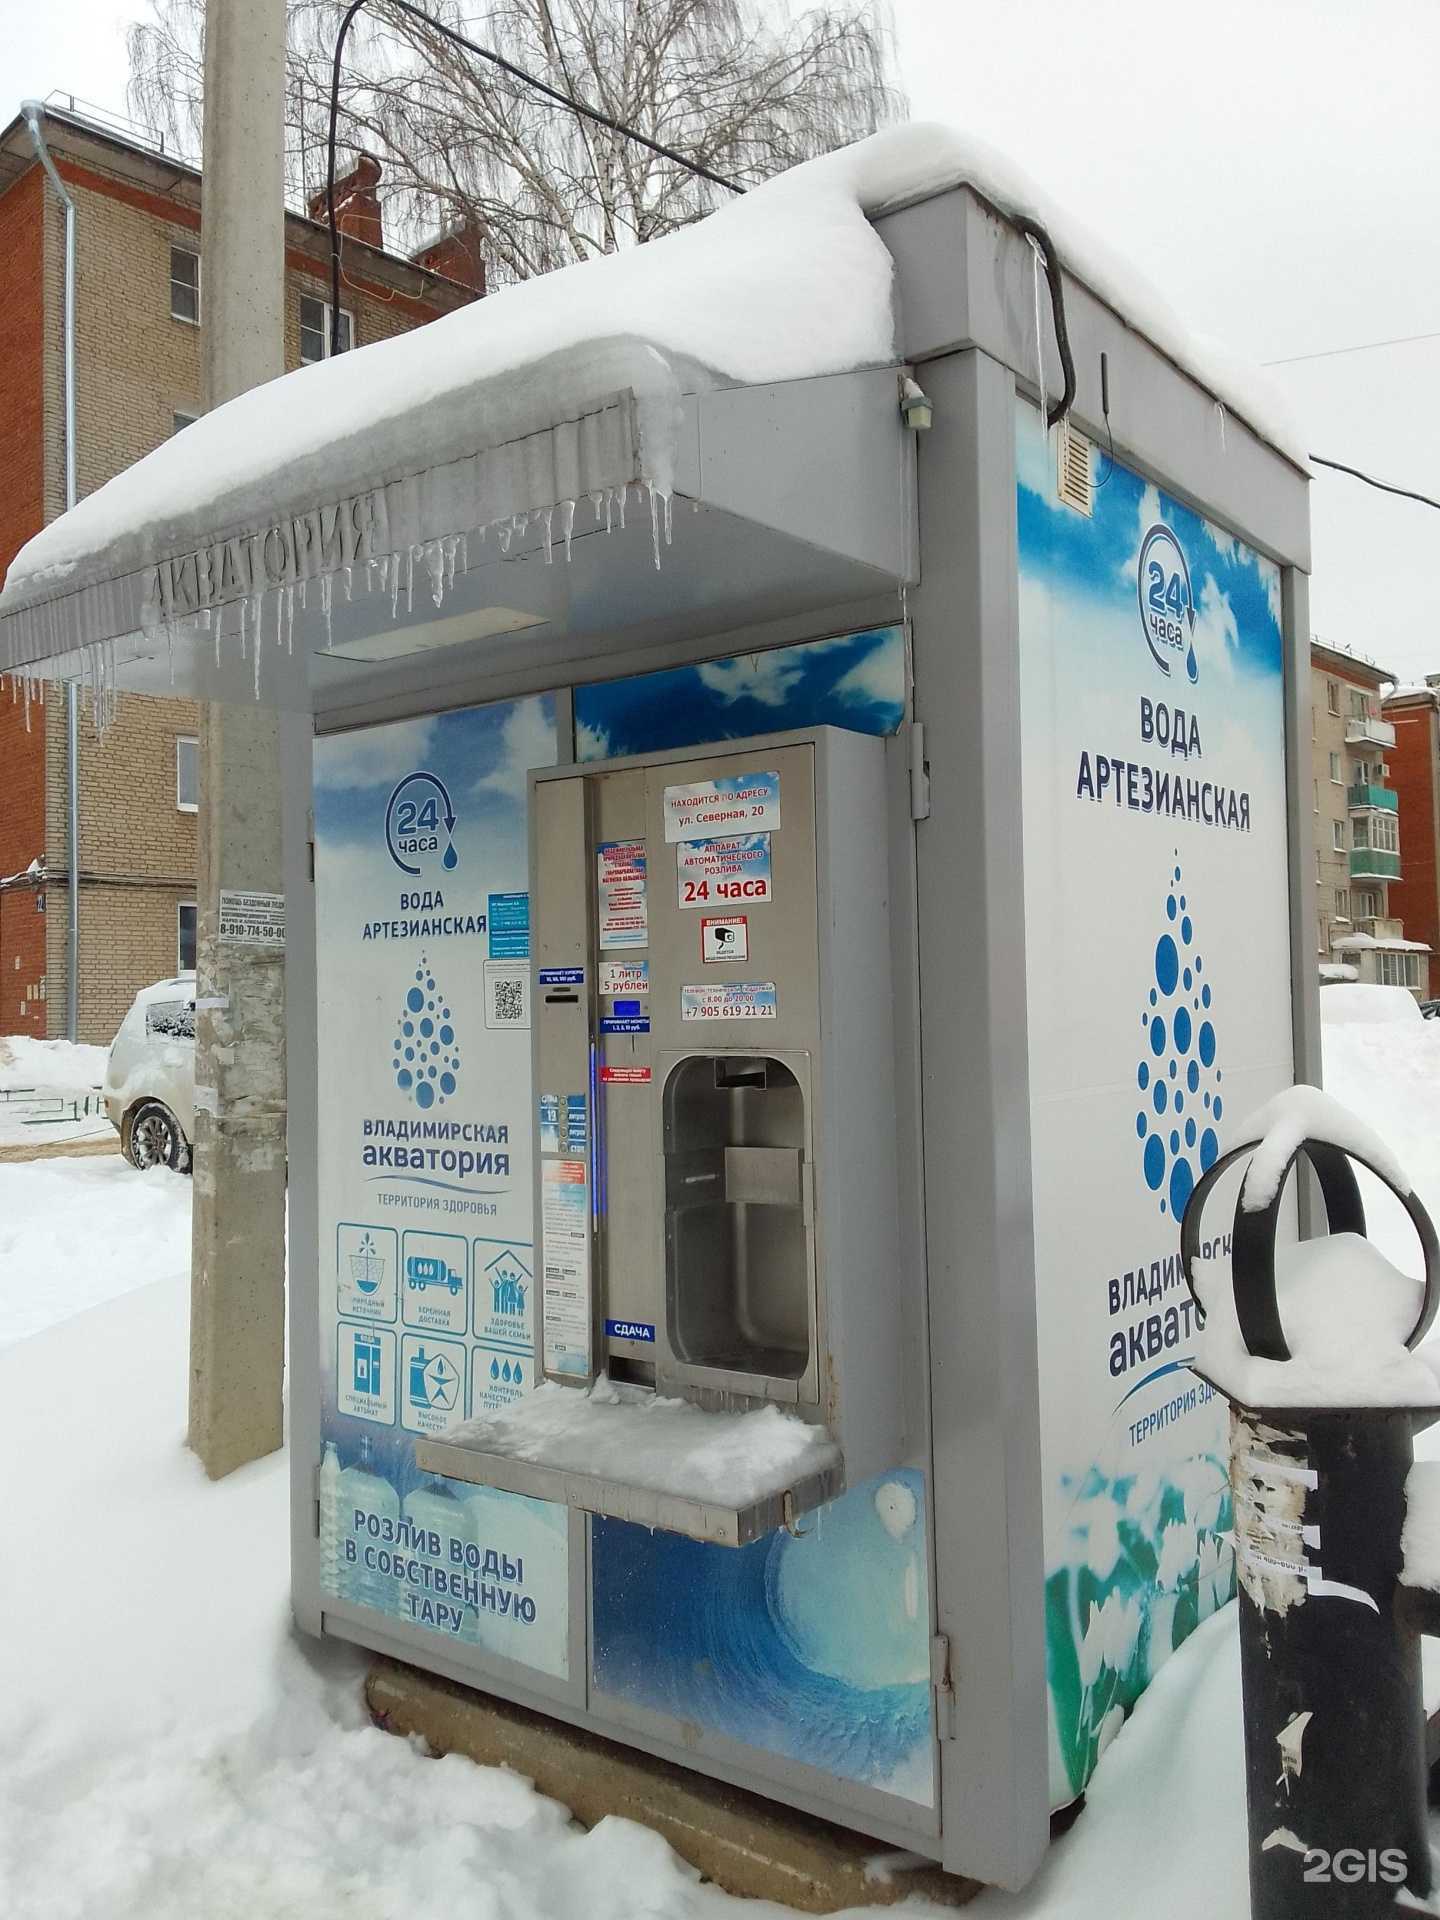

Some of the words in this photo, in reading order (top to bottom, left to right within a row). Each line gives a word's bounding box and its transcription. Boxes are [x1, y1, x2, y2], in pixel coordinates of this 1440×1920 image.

[1149, 561, 1183, 618] 24
[1150, 613, 1182, 647] часа
[1141, 696, 1202, 758] ВОДА
[672, 795, 719, 808] НАХОДИТСЯ
[736, 788, 768, 800] АДРЕСУ
[1077, 751, 1251, 830] АРТЕЗИАНСКАЯ
[397, 798, 439, 834] 24
[679, 817, 693, 827] ул.
[696, 810, 748, 823] Северная,
[752, 806, 764, 816] 20
[399, 836, 438, 853] часа
[705, 842, 741, 852] АППАРАТ
[684, 851, 763, 865] АВТОМАТИЧЕСКОГО
[705, 865, 742, 875] РОЗЛИВА
[400, 891, 444, 911] ВОДА
[684, 880, 709, 902] 24
[717, 880, 766, 899] часа
[363, 915, 487, 940] АРТЕЗИАНСКАЯ
[706, 917, 743, 926] ВНИМАНИЕ!
[610, 969, 615, 978] 1
[619, 970, 642, 980] литр
[604, 982, 610, 990] 5
[613, 981, 648, 992] рублей
[686, 1006, 697, 1016] +7
[701, 1006, 719, 1016] 905
[723, 1005, 742, 1016] 619
[745, 1005, 758, 1015] 21
[761, 1005, 772, 1015] 21
[363, 1120, 508, 1144] ВЛАДИМИРСКАЯ
[363, 1145, 510, 1178] акватория
[377, 1194, 440, 1210] ТЕРРИТОРИЯ
[444, 1200, 497, 1216] ЗДОРОВЬЯ
[491, 1318, 525, 1330] ЗДОРОВЬЕ
[614, 1324, 650, 1338] СДАЧА
[1129, 1388, 1195, 1447] ТЕРРИТОРИЯ
[354, 1509, 441, 1557] РОЗЛИВ
[450, 1538, 523, 1584] ВОДЫ
[345, 1539, 357, 1563] В
[364, 1546, 537, 1624] СОБСТВЕННУЮ
[408, 1593, 463, 1633] ТАРУ
